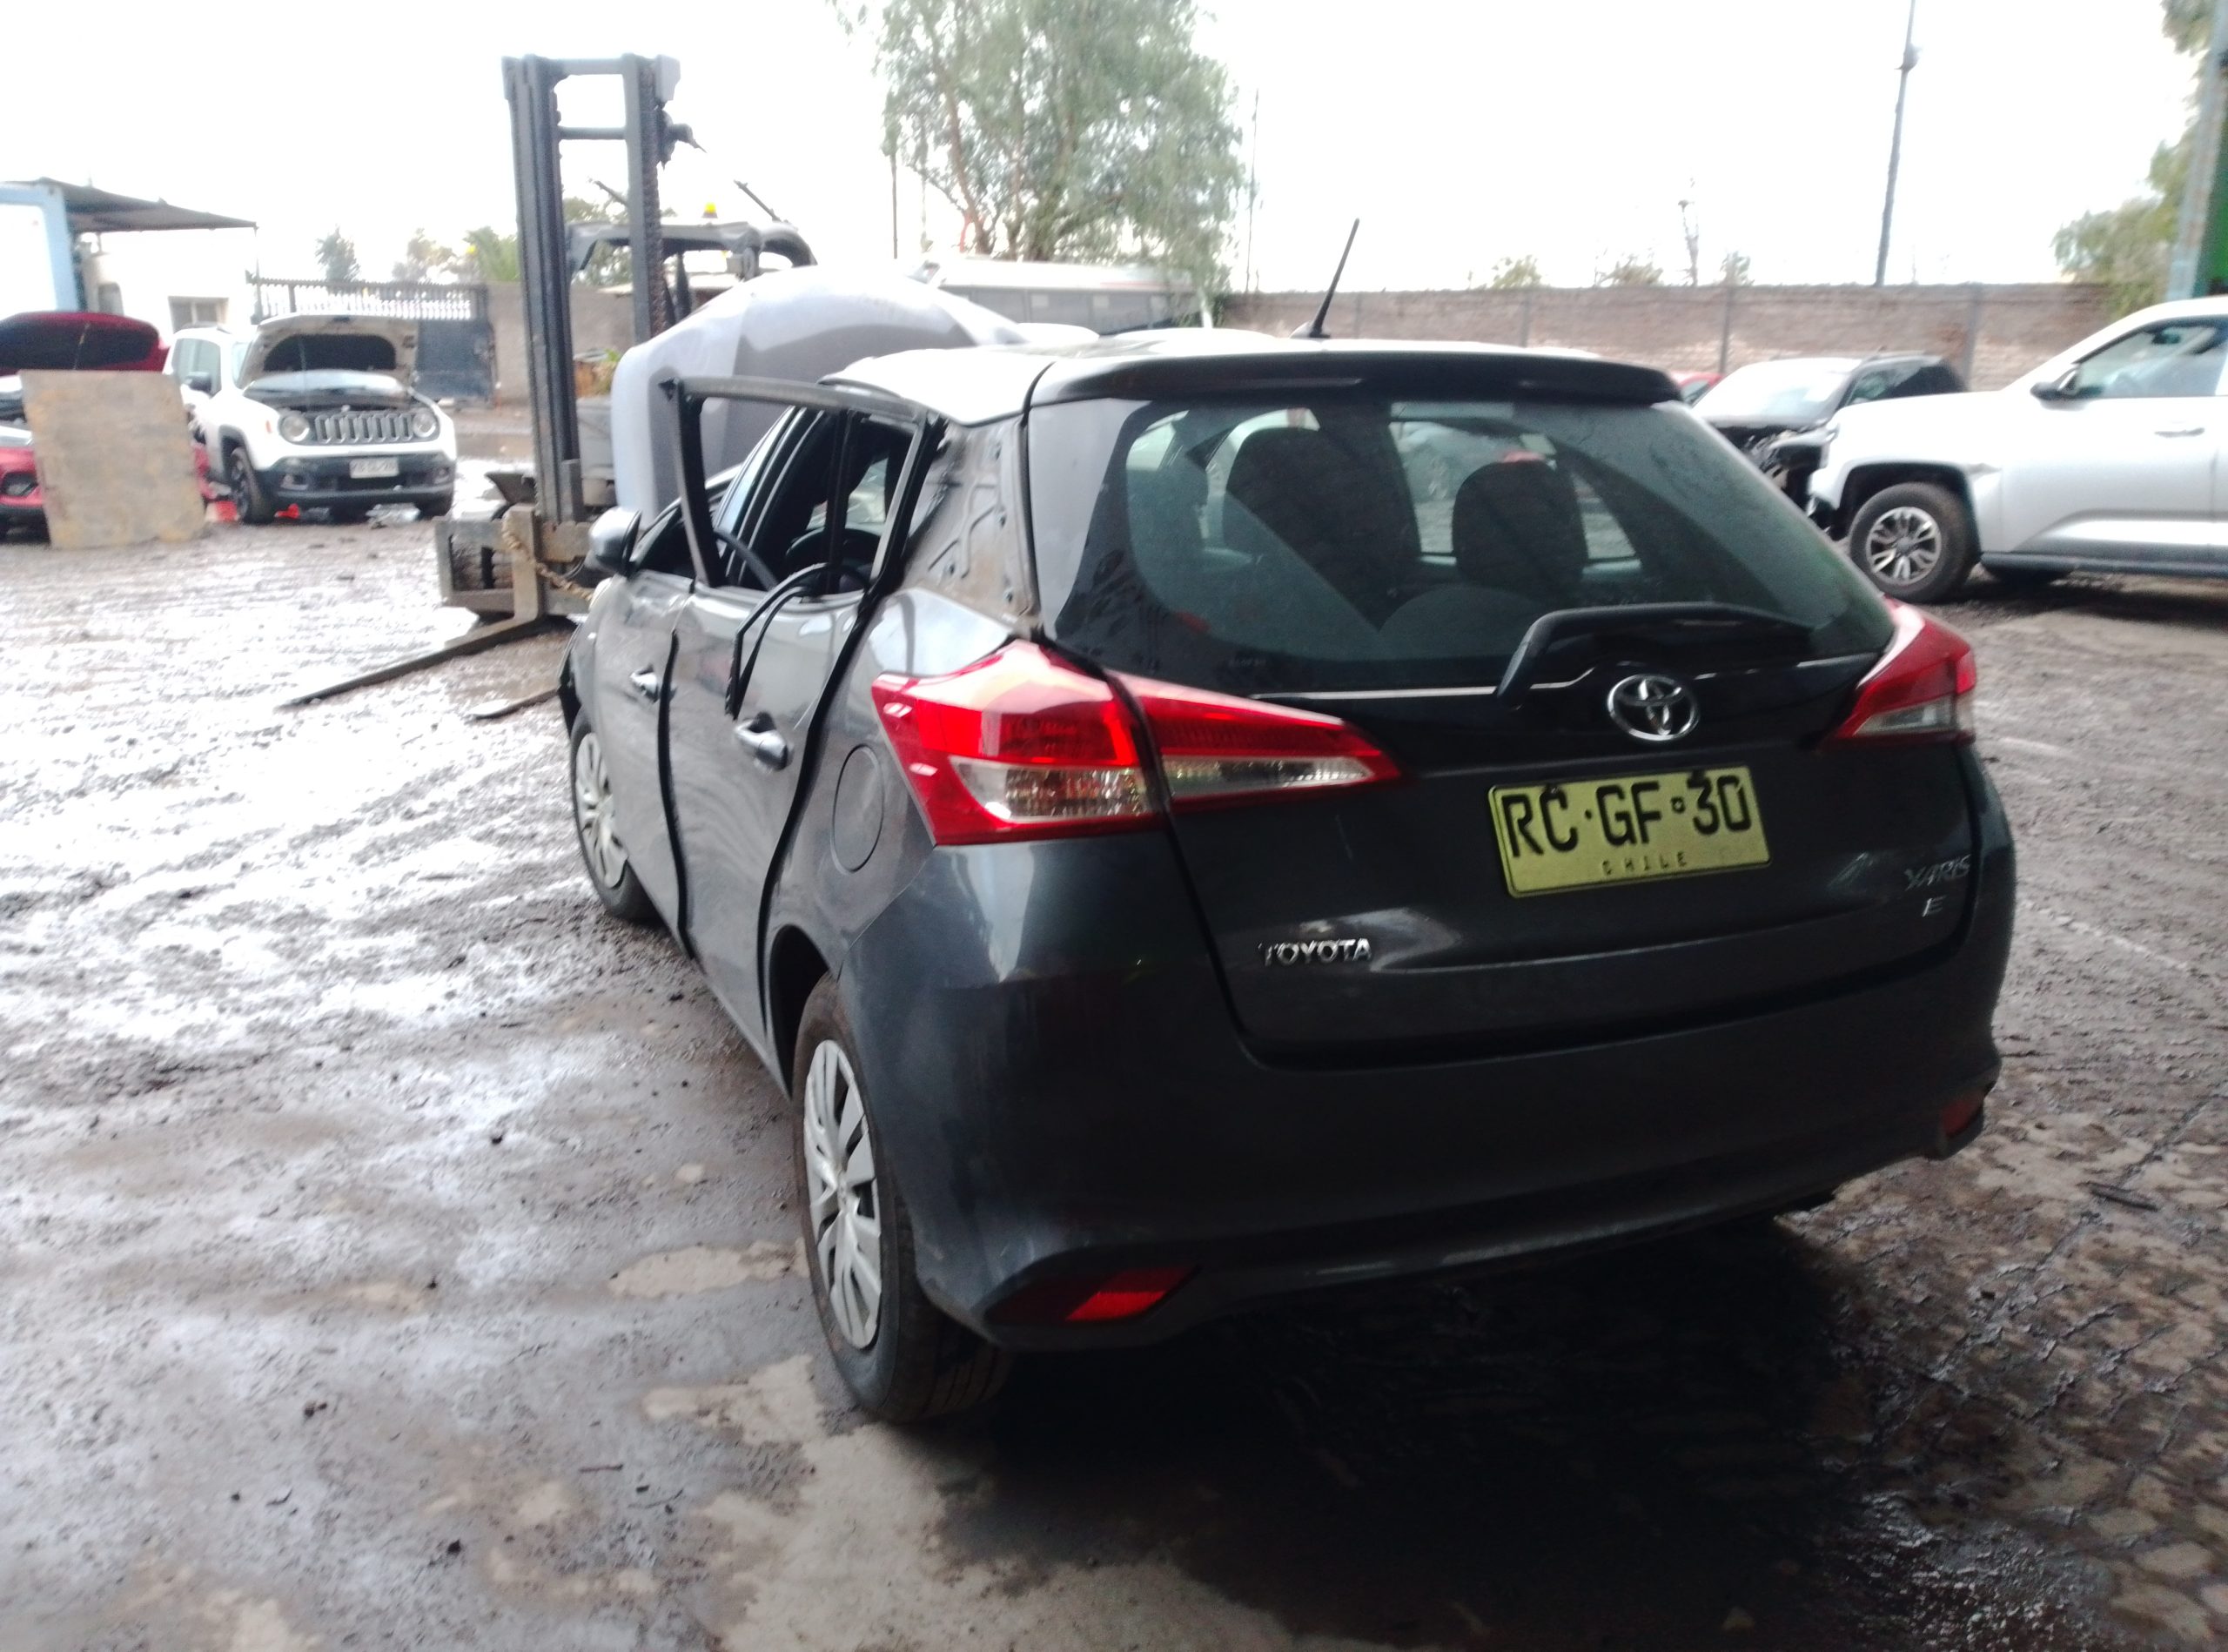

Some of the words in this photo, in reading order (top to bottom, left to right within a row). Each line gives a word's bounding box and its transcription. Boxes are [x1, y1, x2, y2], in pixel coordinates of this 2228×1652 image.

[1601, 850, 1688, 876] CHILE
[1922, 895, 1946, 917] E
[1258, 937, 1372, 966] TOYOTA
